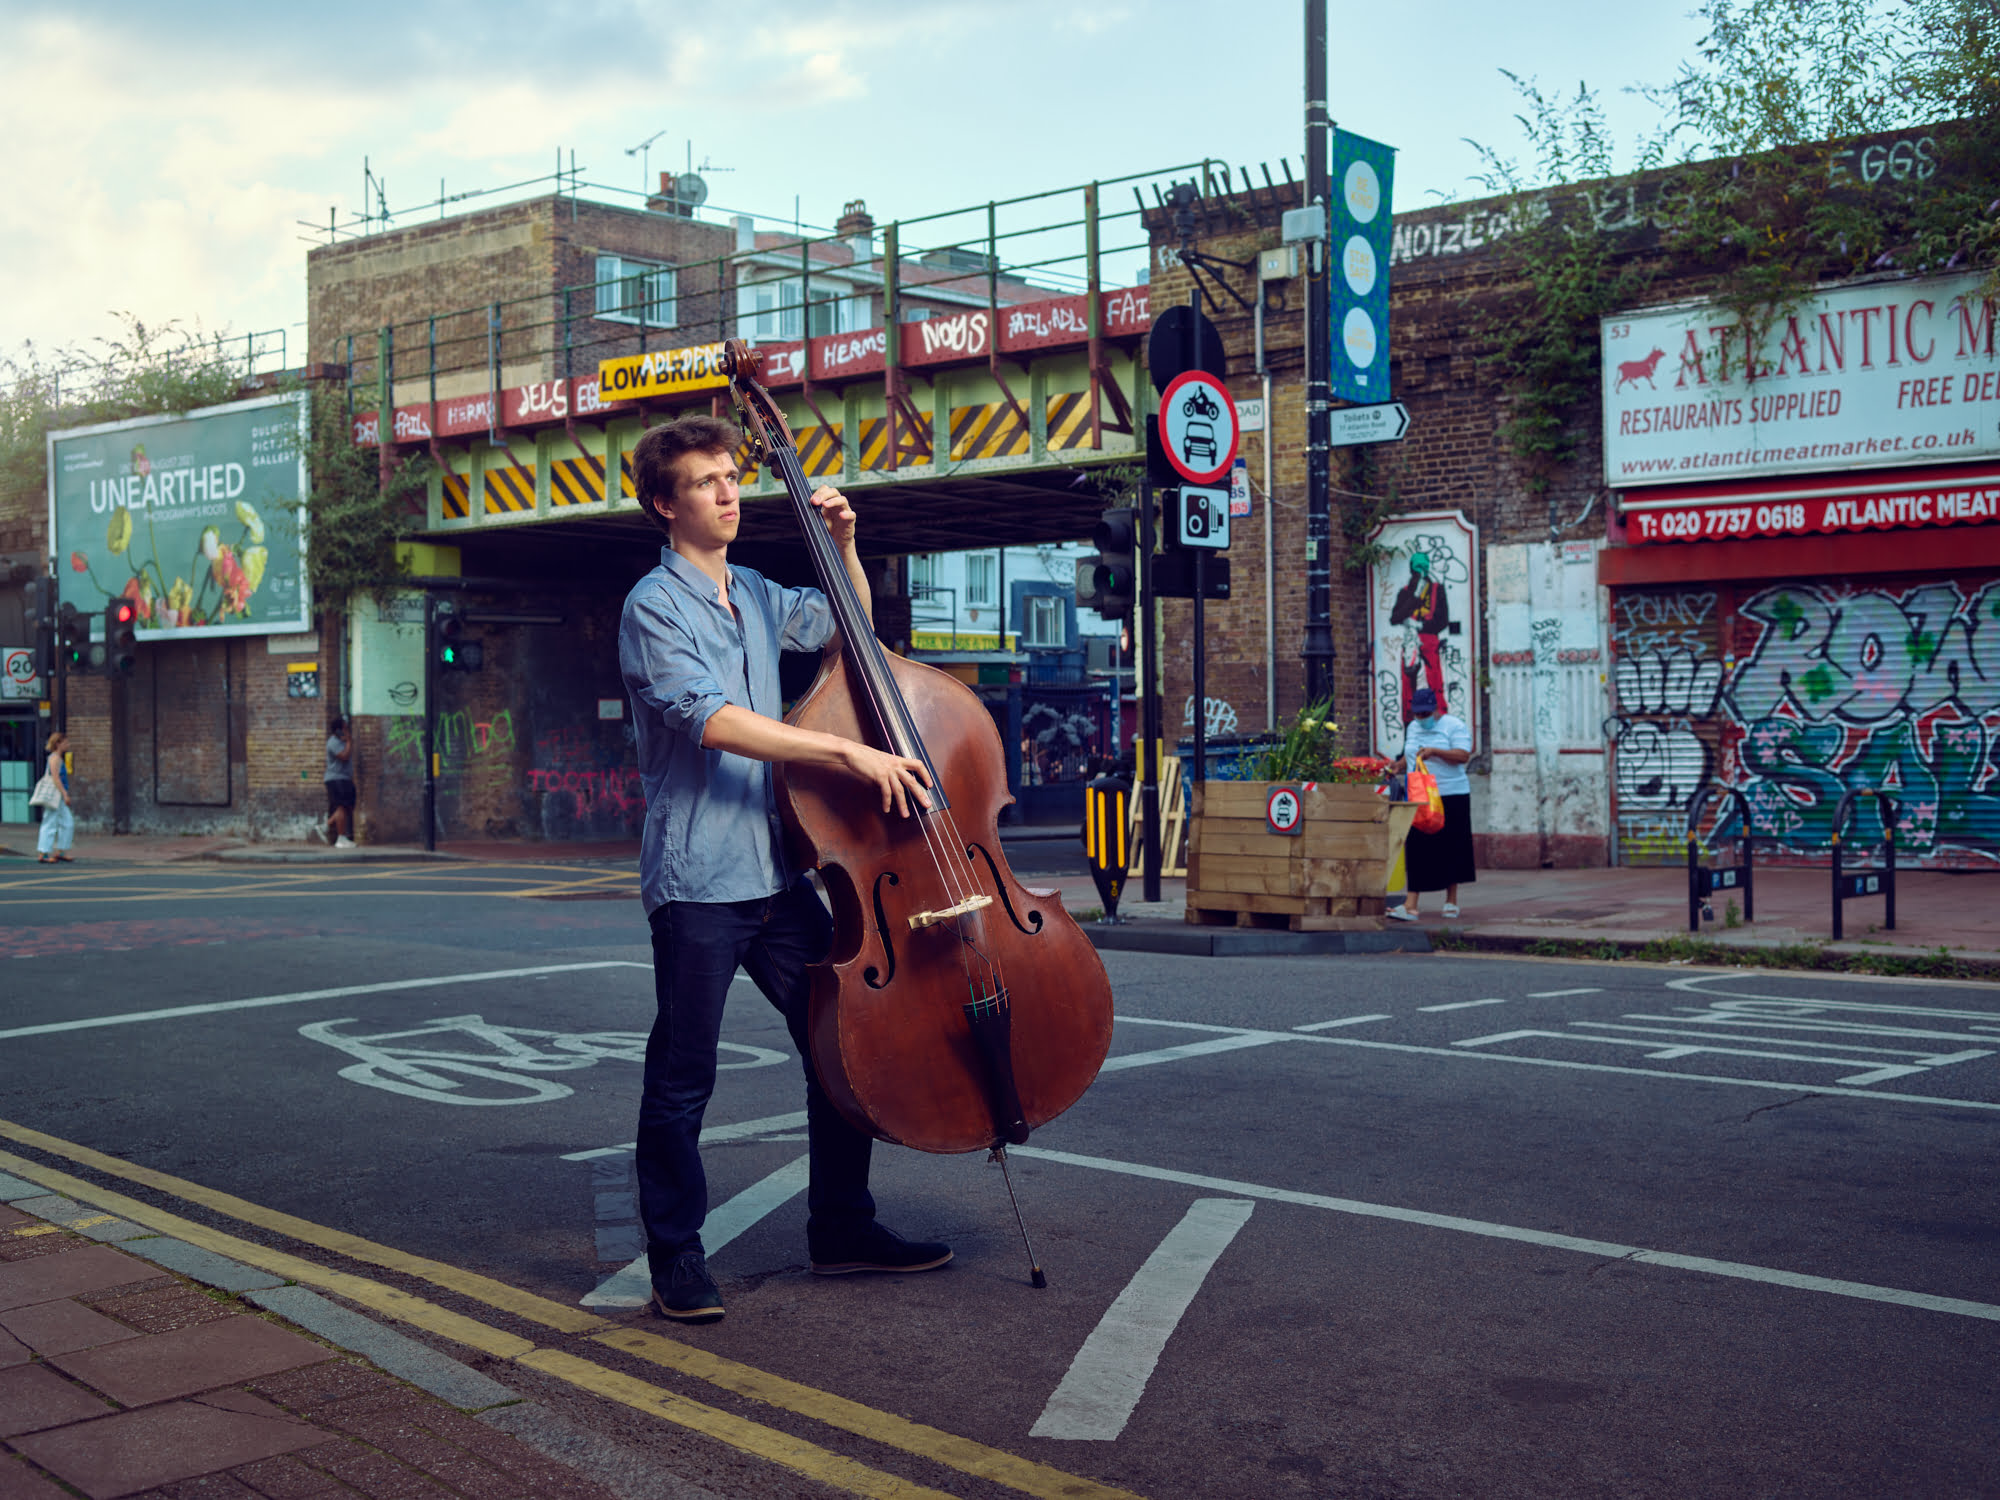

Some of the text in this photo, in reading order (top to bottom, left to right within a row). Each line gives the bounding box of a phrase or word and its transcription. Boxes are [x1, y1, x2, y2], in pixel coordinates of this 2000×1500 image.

[1610, 325, 1631, 340] 53
[1674, 298, 1936, 391] ATLANTIC
[602, 364, 650, 392] LOW
[1897, 371, 2000, 409] FREE DE
[1344, 412, 1370, 423] Toilets
[1620, 389, 1842, 437] RESTAURANTS SUPPLIED
[252, 451, 296, 467] GALLERY
[1620, 427, 1976, 475] www.atlanticmeatmarket.co.uk
[90, 463, 245, 514] UNEARTHED
[202, 502, 228, 516] ROOTS
[1638, 504, 1806, 537] T: 020 7737 0618
[1823, 489, 2000, 527] ATLANTIC MEAT
[11, 661, 33, 674] 20
